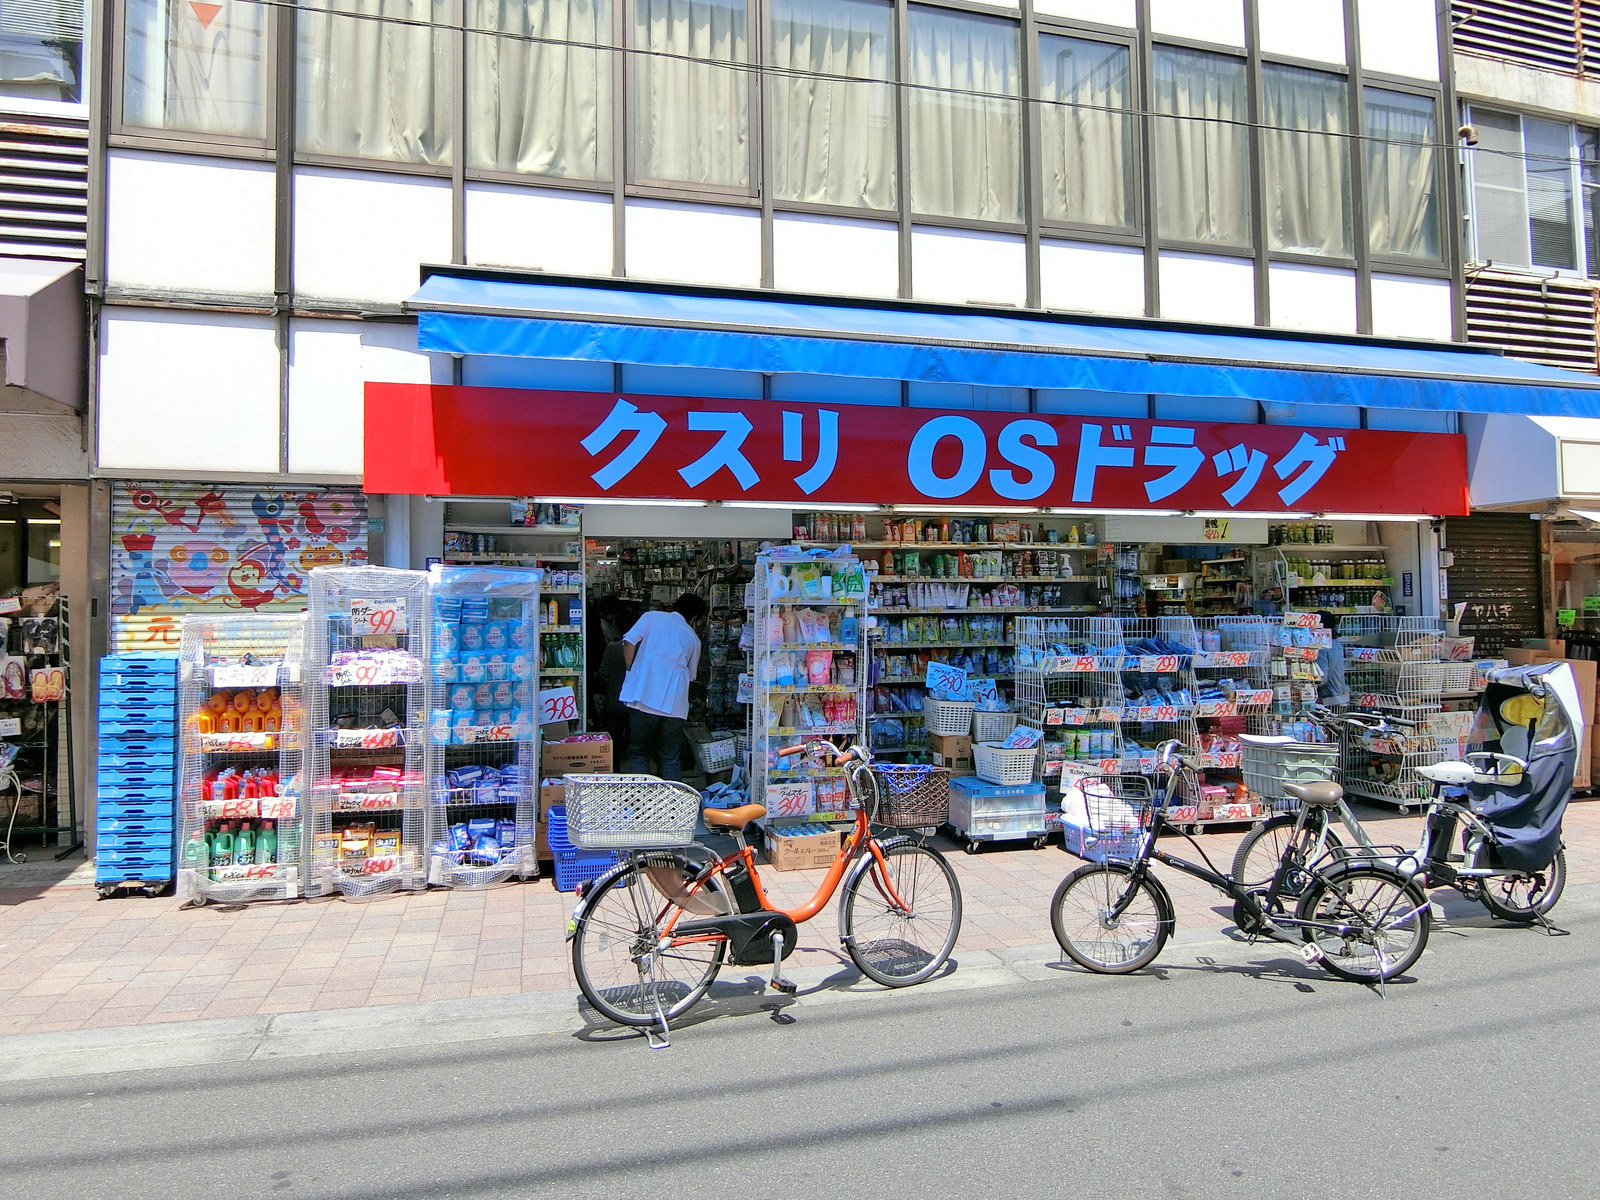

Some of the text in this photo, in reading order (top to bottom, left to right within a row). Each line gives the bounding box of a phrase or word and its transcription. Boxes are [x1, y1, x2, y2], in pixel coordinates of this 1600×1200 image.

[580, 398, 1346, 508] クスリ OSドラッグ
[370, 609, 396, 634] 99
[1074, 656, 1095, 671] 158
[1156, 656, 1176, 672] 299
[355, 666, 379, 685] 99
[544, 695, 576, 720] 398
[362, 730, 396, 748] 498
[488, 726, 512, 740] 85
[778, 794, 807, 817] 399
[362, 856, 393, 874] 880
